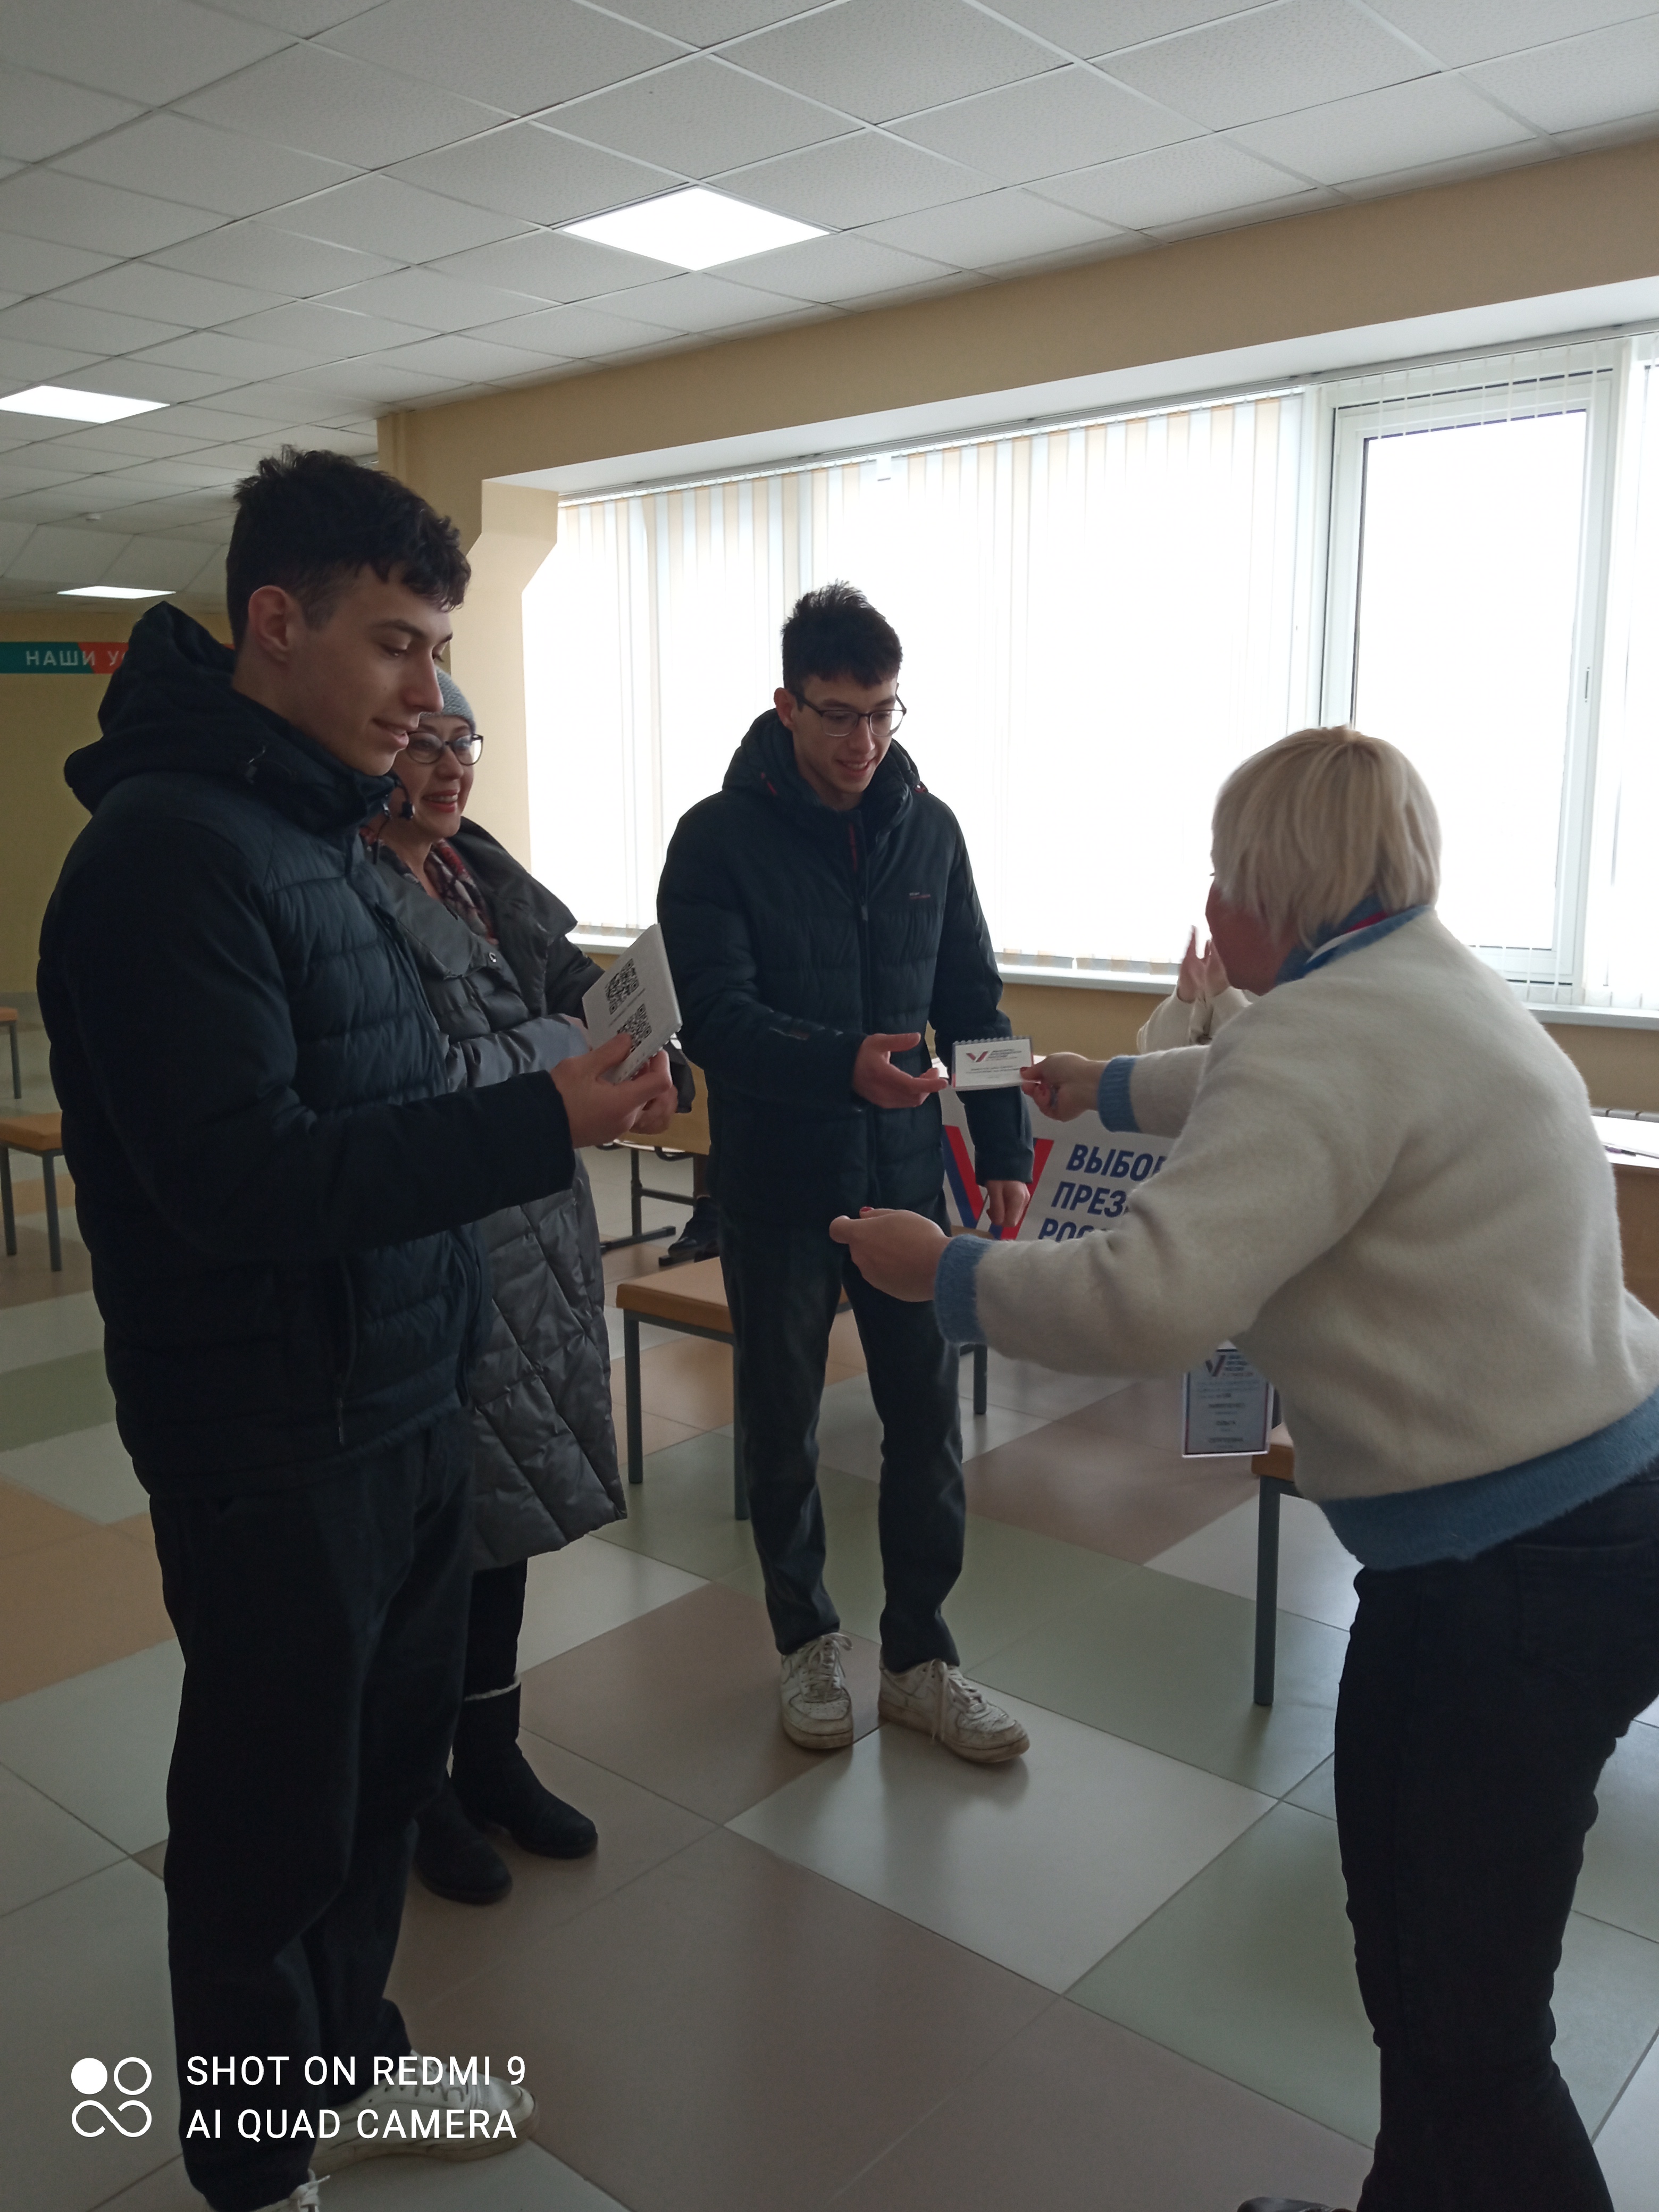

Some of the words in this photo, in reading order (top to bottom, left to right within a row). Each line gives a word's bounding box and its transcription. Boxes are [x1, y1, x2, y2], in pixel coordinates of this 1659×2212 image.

[26, 650, 95, 666] НАШИ
[107, 650, 127, 666] У
[1051, 1181, 1129, 1218] ПРЕЗ
